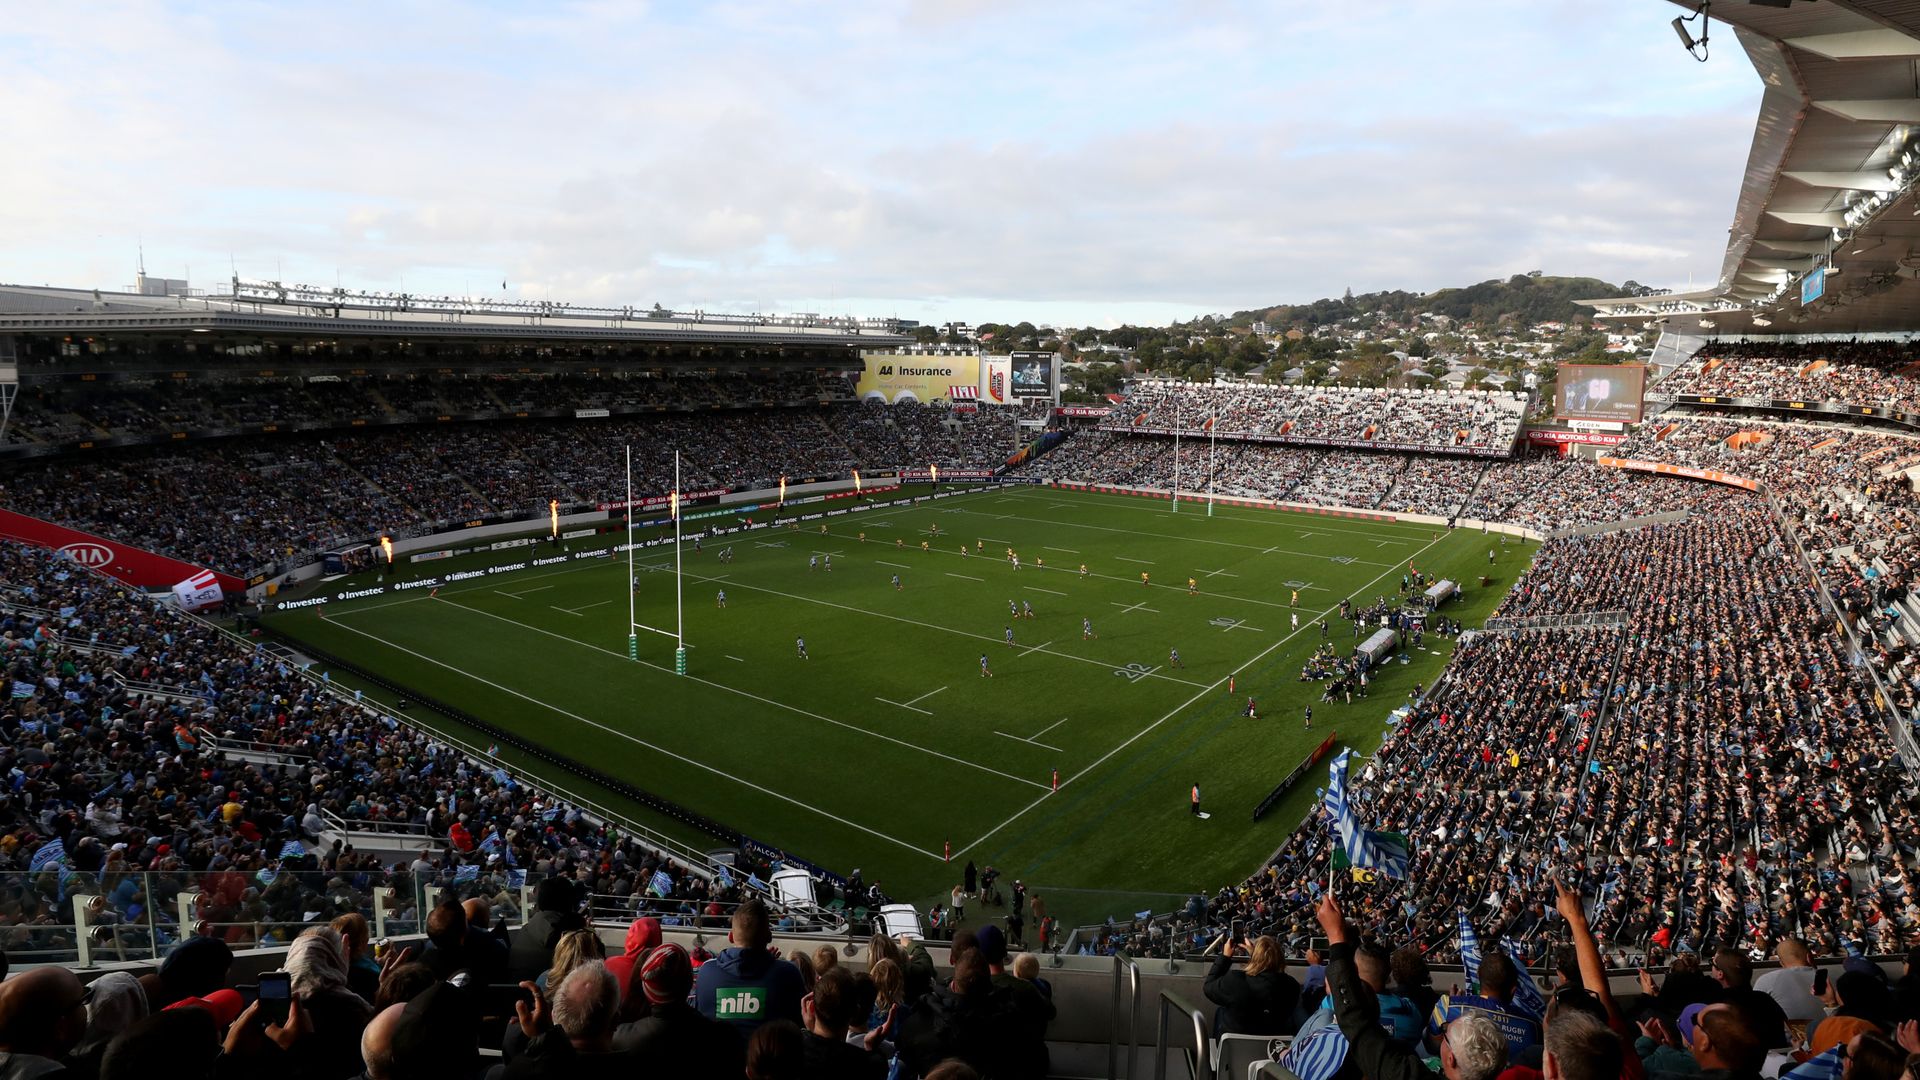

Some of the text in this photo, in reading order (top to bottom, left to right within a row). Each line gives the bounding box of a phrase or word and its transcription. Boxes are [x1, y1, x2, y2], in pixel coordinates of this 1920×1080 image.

[879, 366, 952, 376] AA Insurance
[64, 549, 105, 563] KIA
[581, 549, 607, 558] Investec
[539, 556, 567, 566] Investec
[495, 562, 526, 573] Investec
[452, 570, 485, 581] Investec
[401, 578, 437, 589] Investec
[346, 587, 384, 599] Investec
[287, 596, 328, 609] Investec
[1113, 663, 1152, 679] 22
[720, 992, 760, 1013] nib
[1502, 1025, 1526, 1036] RUGBY
